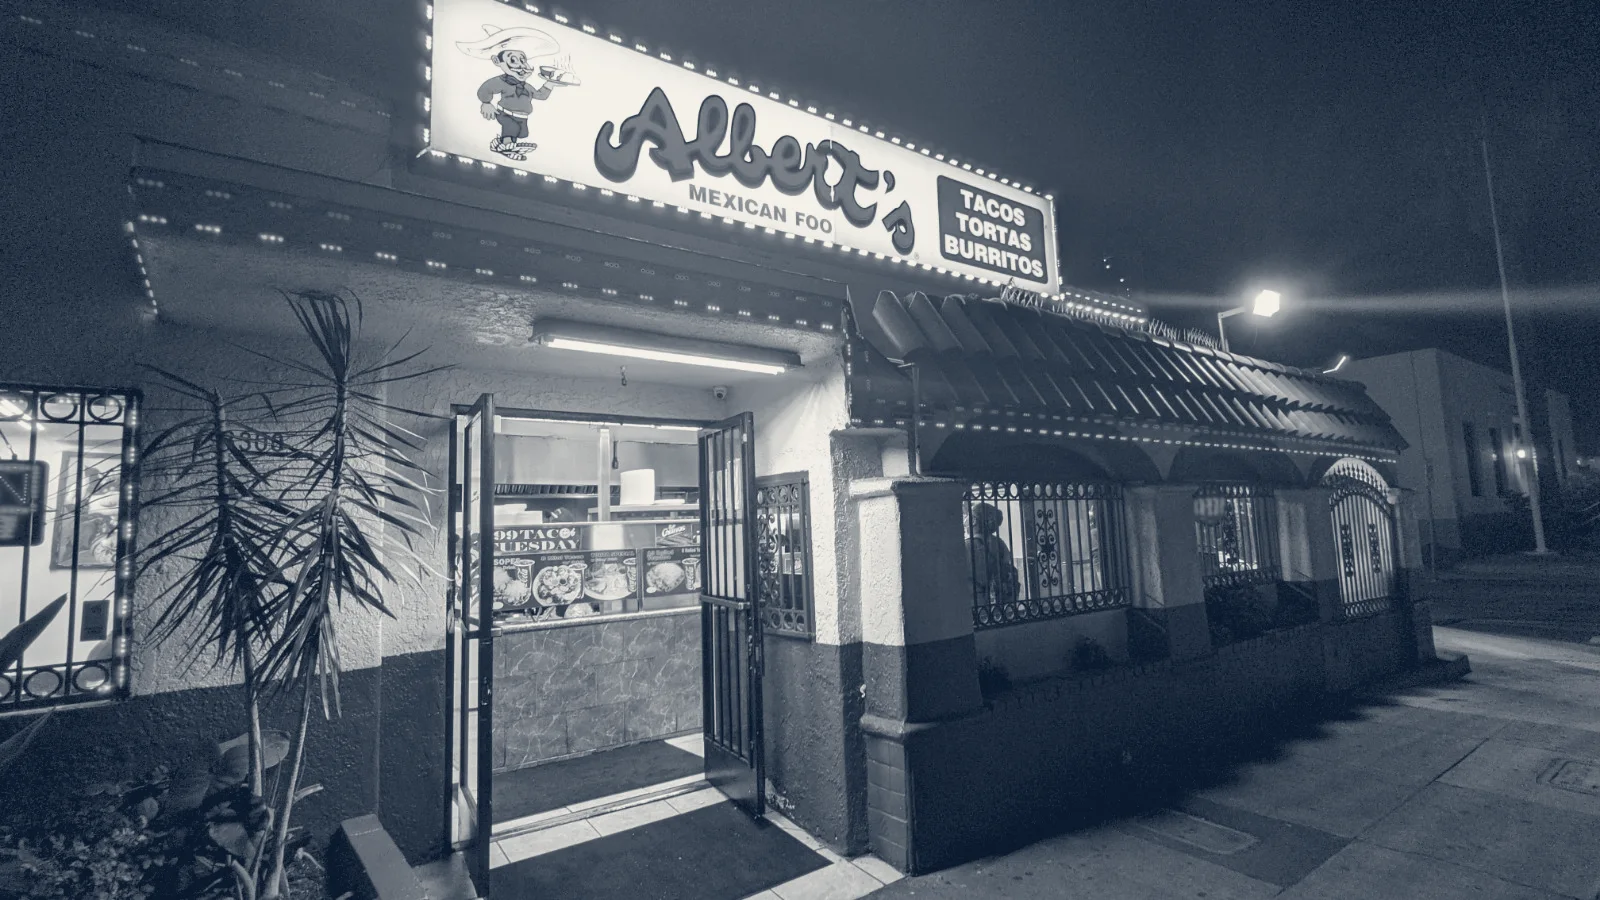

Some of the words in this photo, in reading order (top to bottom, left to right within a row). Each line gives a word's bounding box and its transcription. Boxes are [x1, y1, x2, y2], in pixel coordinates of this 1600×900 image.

[594, 87, 915, 256] Albert's
[689, 183, 787, 223] MEXICAN
[795, 211, 833, 235] FOO
[960, 188, 1026, 227] TACOS
[955, 211, 1032, 252] TORTAS
[944, 233, 1044, 278] BURRITOS
